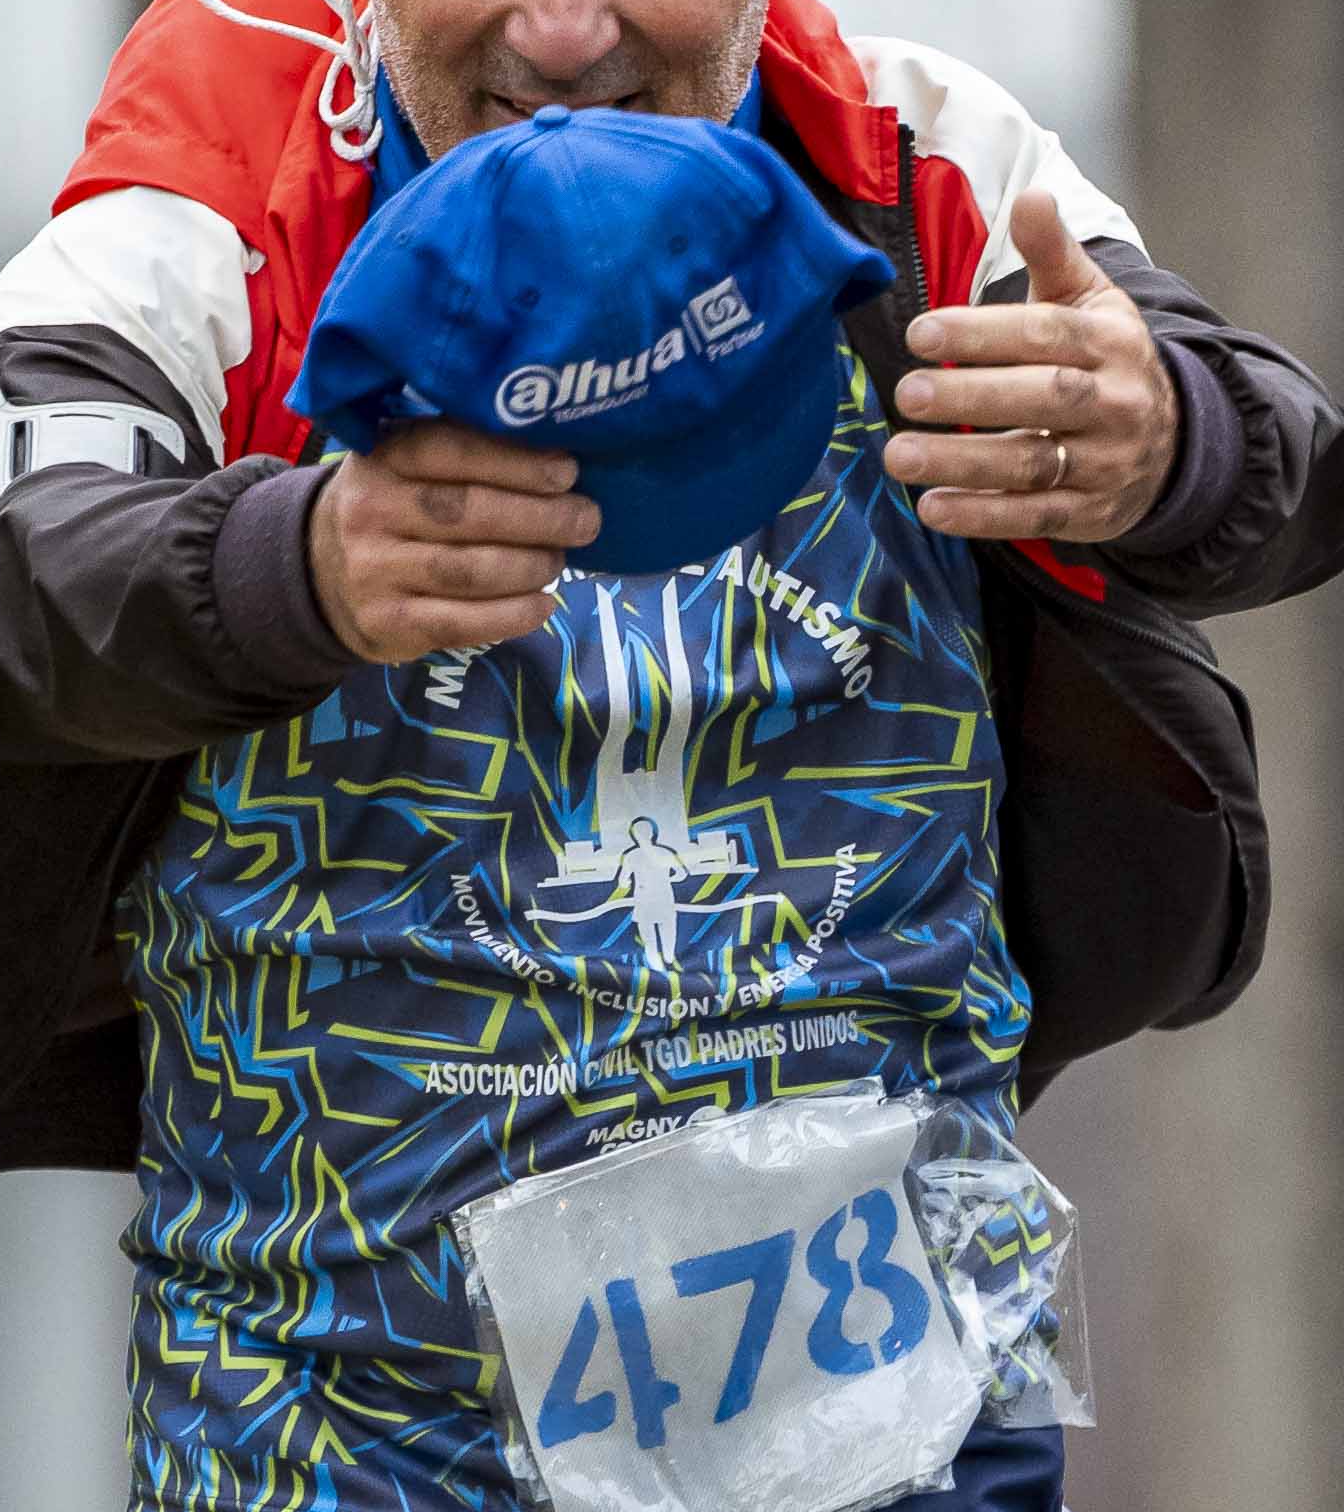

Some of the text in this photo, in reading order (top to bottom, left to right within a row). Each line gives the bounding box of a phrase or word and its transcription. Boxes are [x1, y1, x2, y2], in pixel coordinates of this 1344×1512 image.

[716, 545, 873, 699] AUTISMO
[714, 992, 731, 1015] Y
[806, 842, 857, 954] POSITIVA
[425, 1009, 859, 1097] ASOCIACIÓN CIVIL TGD PADRES UNIDOS
[584, 1115, 683, 1146] MAGNY
[535, 1187, 931, 1450] 478
